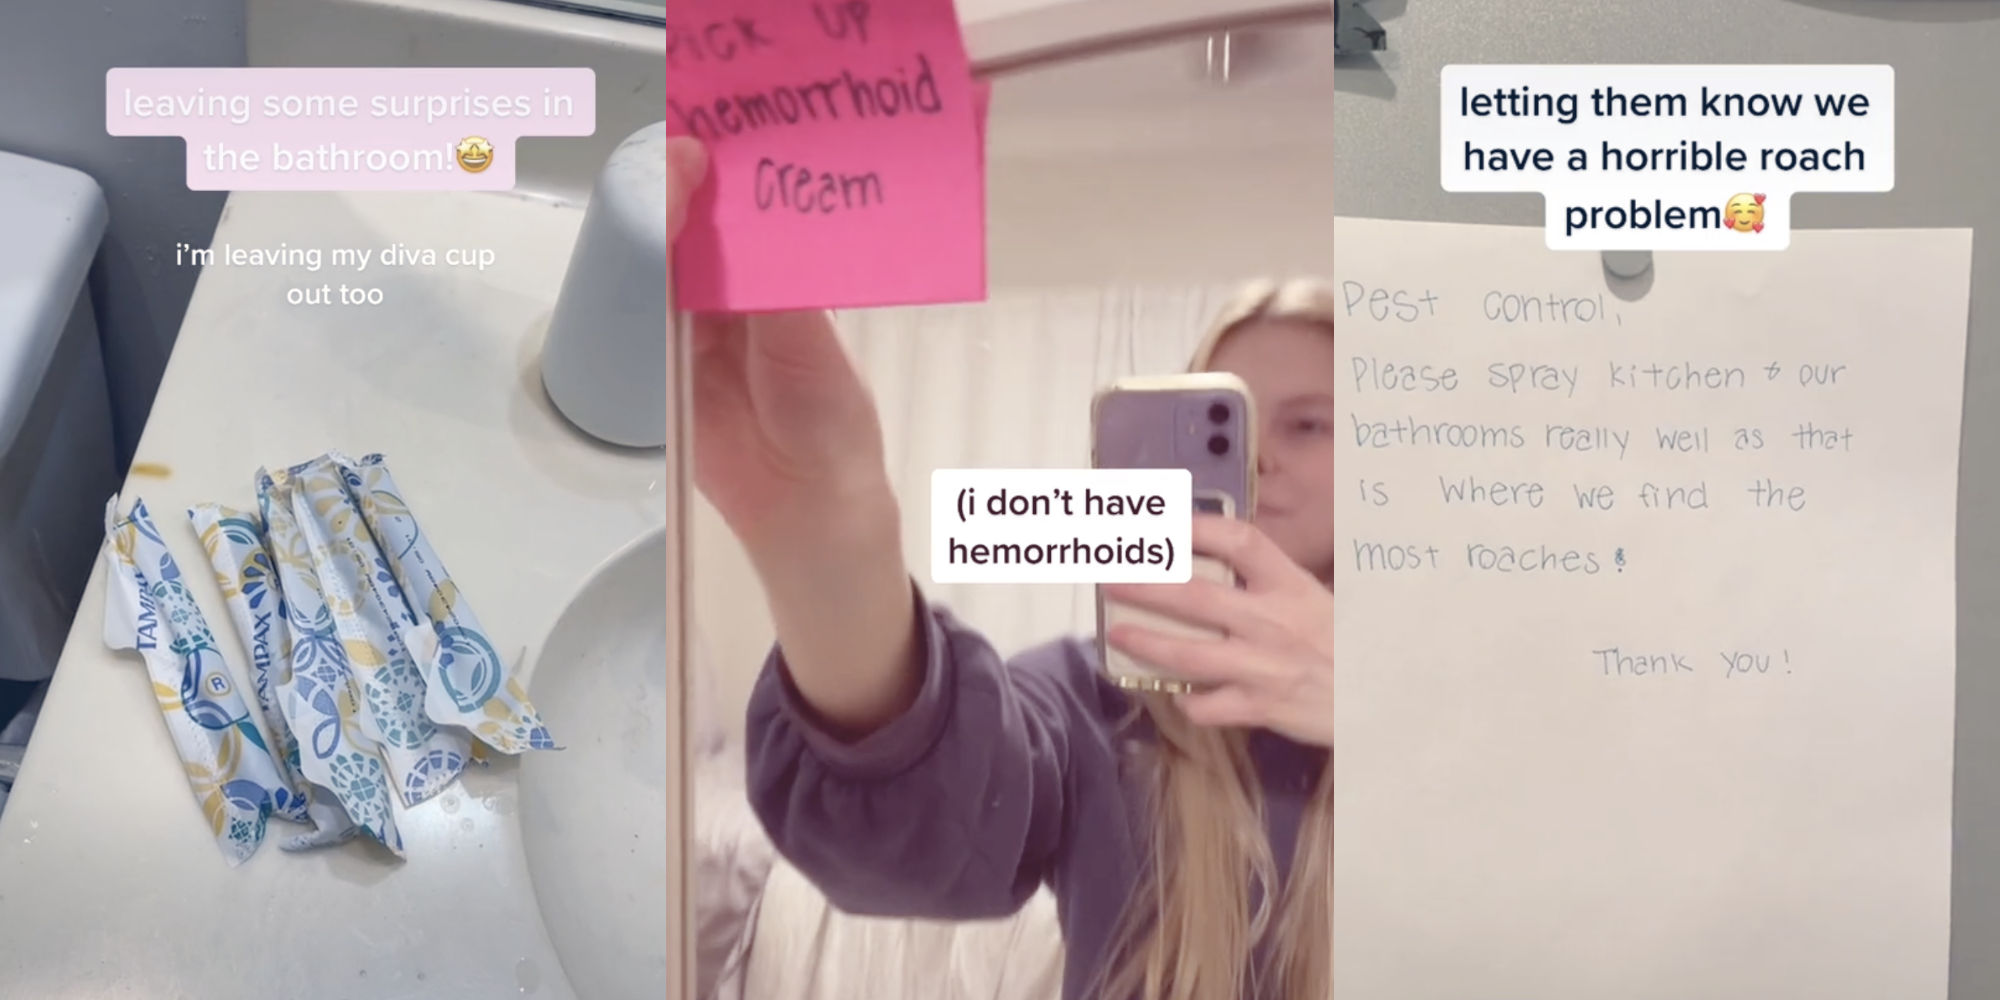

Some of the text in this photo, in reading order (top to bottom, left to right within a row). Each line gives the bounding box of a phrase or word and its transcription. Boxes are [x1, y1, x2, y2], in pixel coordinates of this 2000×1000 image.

[1342, 279, 1439, 323] Pest
[1351, 356, 1459, 393] Please
[1487, 362, 1578, 399] spray
[1609, 361, 1745, 391] kitchen
[1799, 363, 1847, 388] our
[1350, 412, 1854, 461] bathrooms really well as that
[1359, 478, 1390, 507] is
[1572, 483, 1615, 511] we
[1637, 480, 1709, 510] find
[1747, 477, 1806, 512] the
[1352, 538, 1440, 572] most
[1591, 646, 1694, 676] Thank
